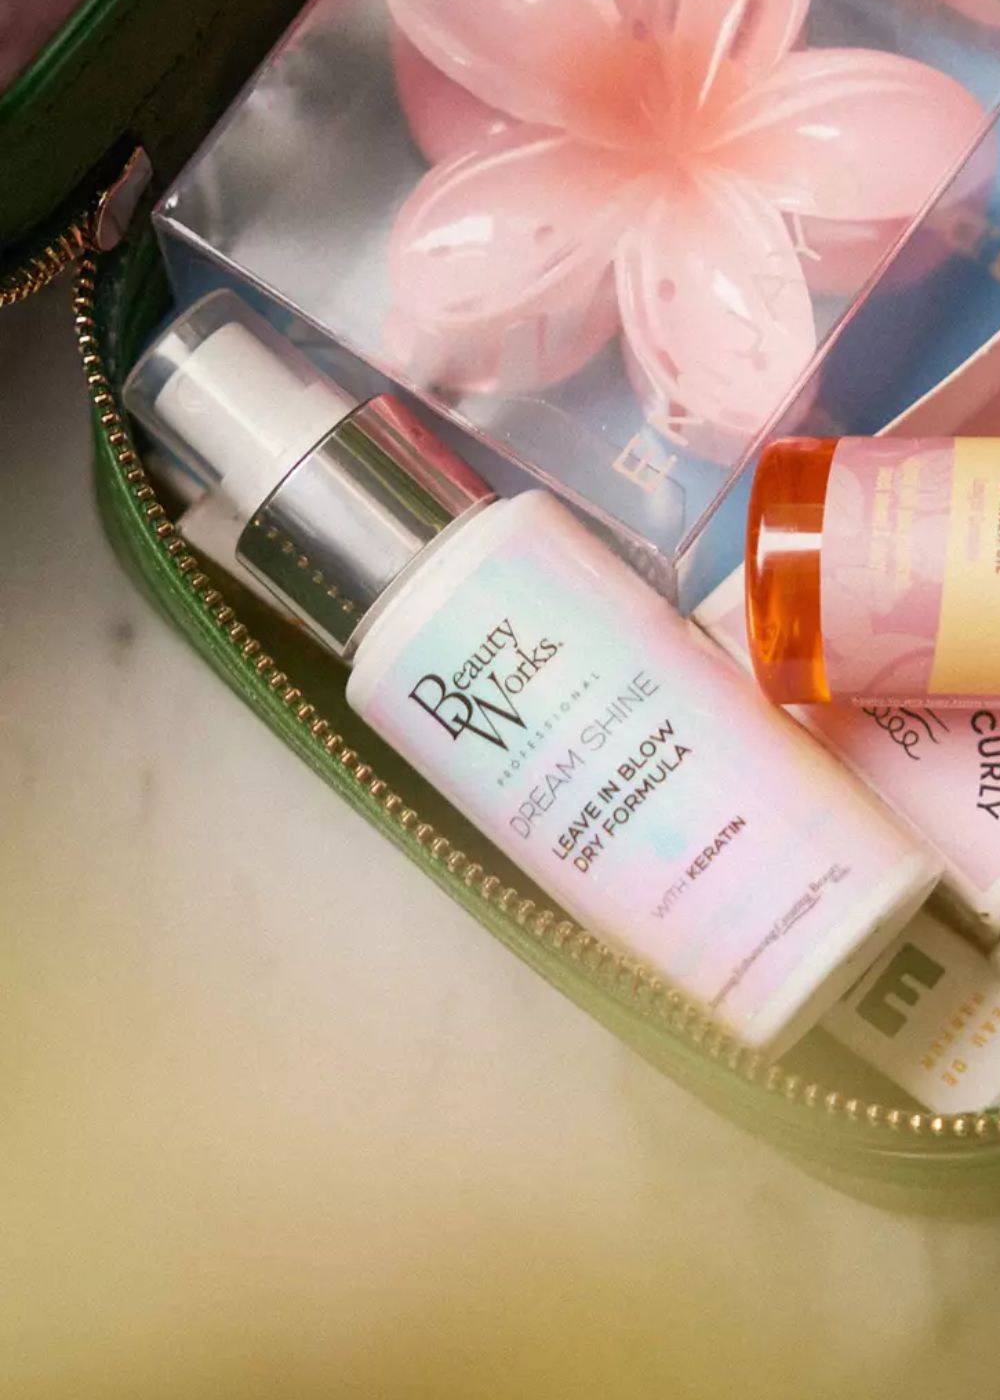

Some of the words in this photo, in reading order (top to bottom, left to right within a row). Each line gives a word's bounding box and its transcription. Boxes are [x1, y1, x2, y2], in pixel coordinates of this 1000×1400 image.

[407, 615, 522, 742] Beauty
[495, 670, 601, 787] PROFESSIONAL
[508, 748, 587, 841] DREAM
[578, 669, 663, 753] SHINE
[551, 802, 602, 862] LEAVE
[595, 776, 622, 809] IN
[616, 717, 677, 782] BLOW
[572, 834, 608, 874] DRY
[602, 741, 694, 839] FORMULA
[651, 873, 690, 921] WITH
[684, 813, 748, 881] KERATIN
